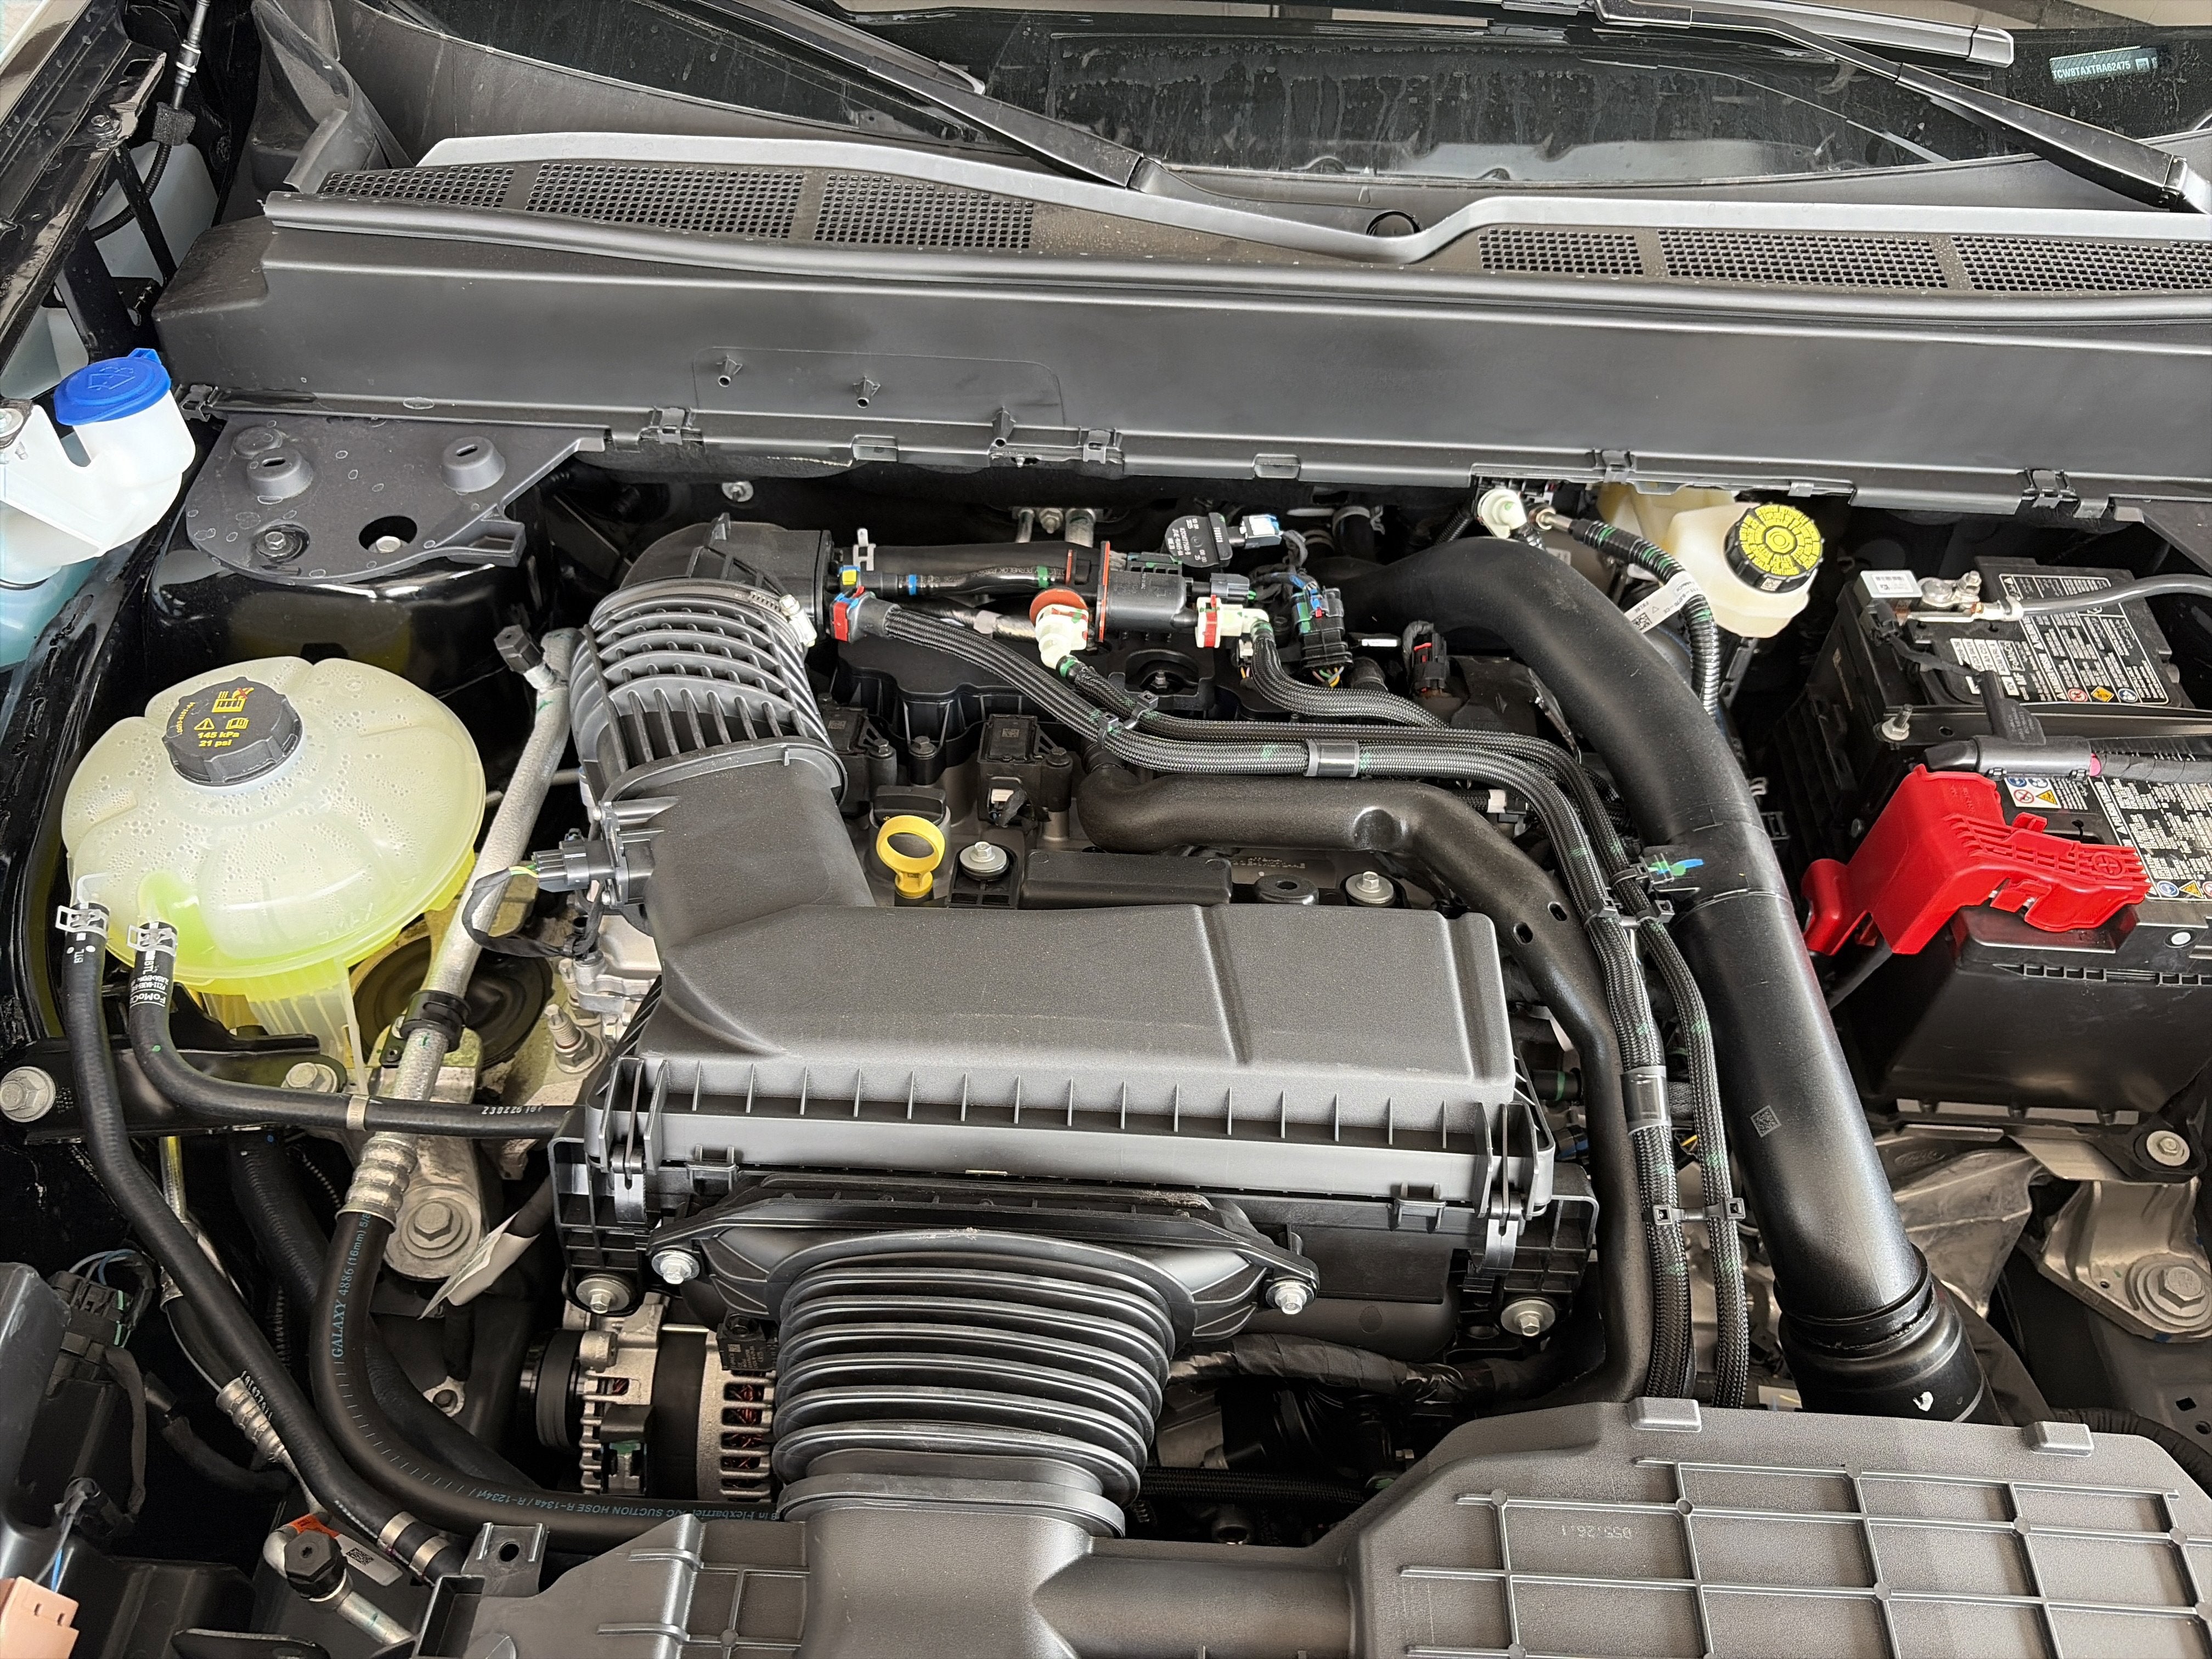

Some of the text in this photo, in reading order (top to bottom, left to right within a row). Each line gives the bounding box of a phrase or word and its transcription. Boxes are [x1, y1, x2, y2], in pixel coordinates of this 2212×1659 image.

[74, 949, 84, 963] BTL
[143, 961, 154, 975] BTL
[347, 1229, 366, 1266] (16mm)
[338, 1268, 353, 1296] 4886
[331, 1299, 346, 1358] GALAXY
[534, 1498, 575, 1511] R-134a
[576, 1503, 609, 1514] HOSE
[612, 1505, 663, 1517] SUCTION
